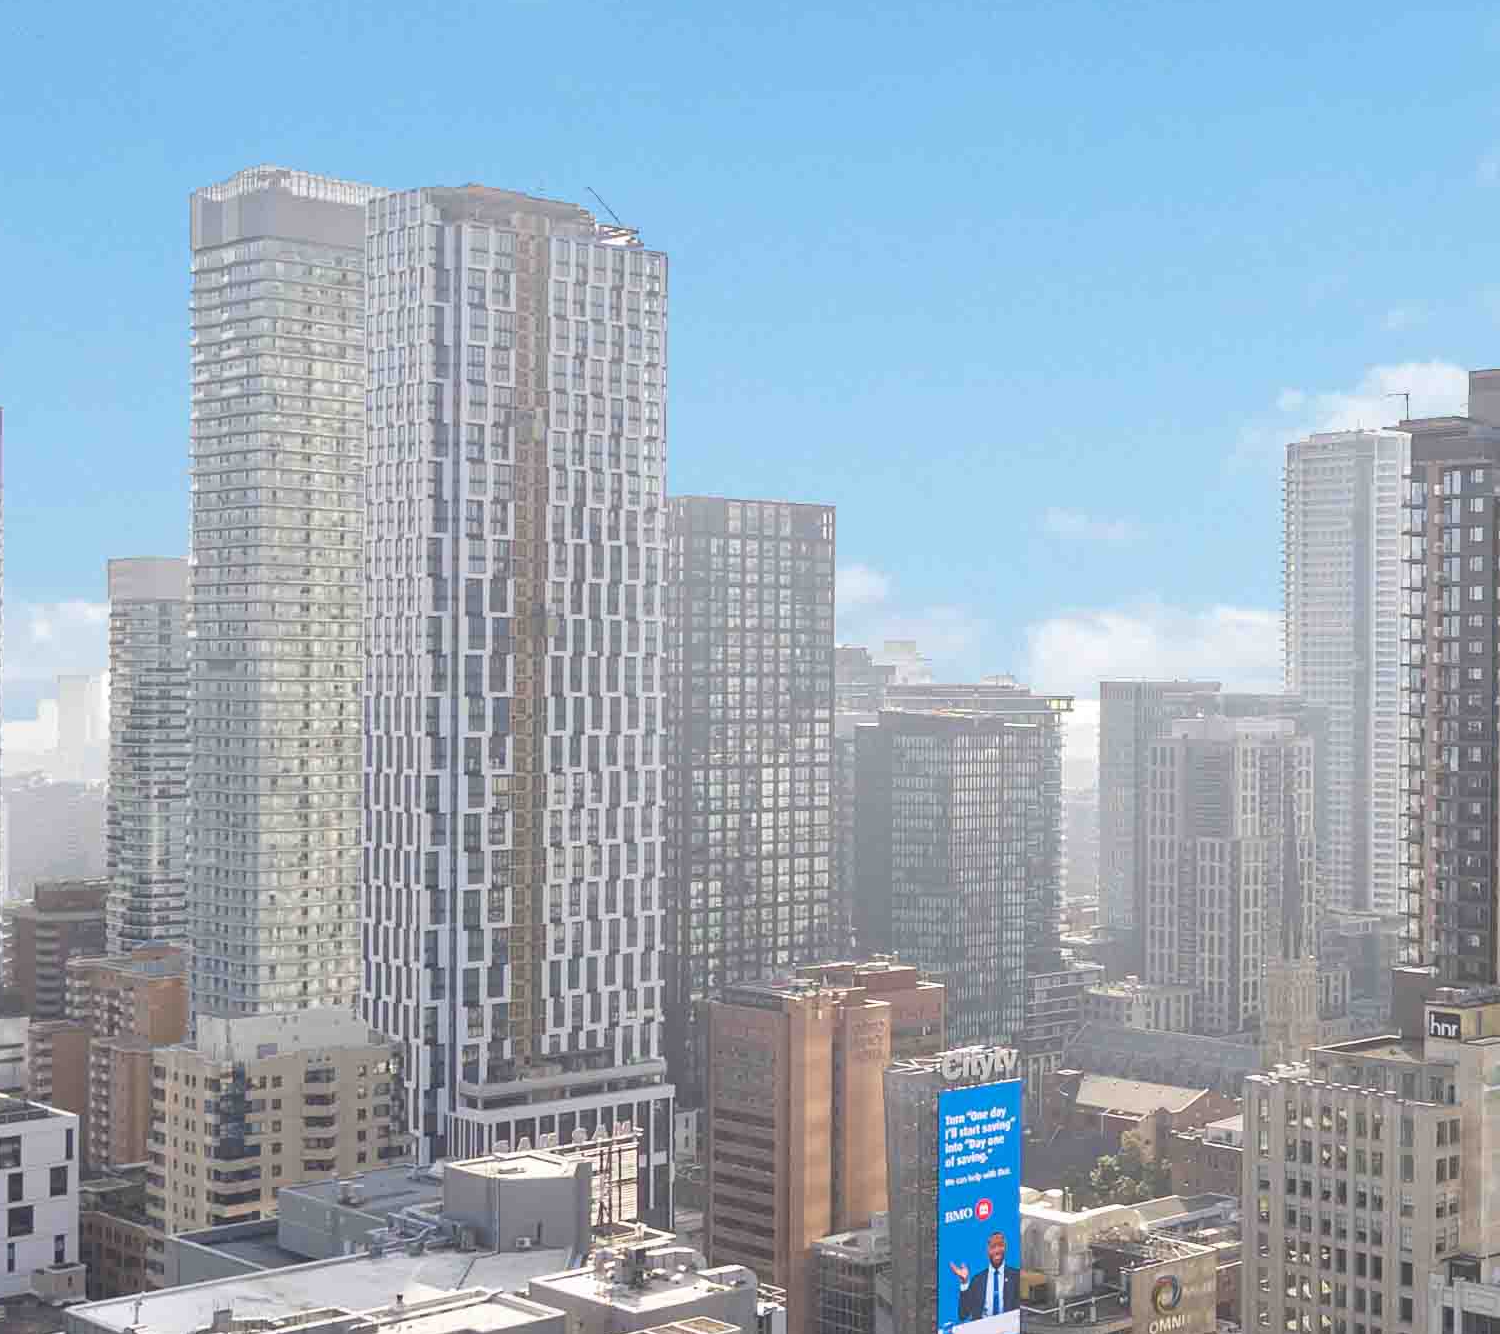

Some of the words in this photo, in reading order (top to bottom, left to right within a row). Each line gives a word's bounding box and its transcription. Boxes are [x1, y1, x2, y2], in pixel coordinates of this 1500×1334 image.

[1430, 1013, 1459, 1037] hnr
[945, 1115, 966, 1126] Turn
[990, 1107, 1007, 1119] day
[960, 1125, 981, 1138] start
[945, 1142, 964, 1155] into
[988, 1135, 1005, 1146] one
[945, 1156, 955, 1167] of
[945, 1207, 973, 1224] BMO
[1149, 1314, 1186, 1334] OMNI
